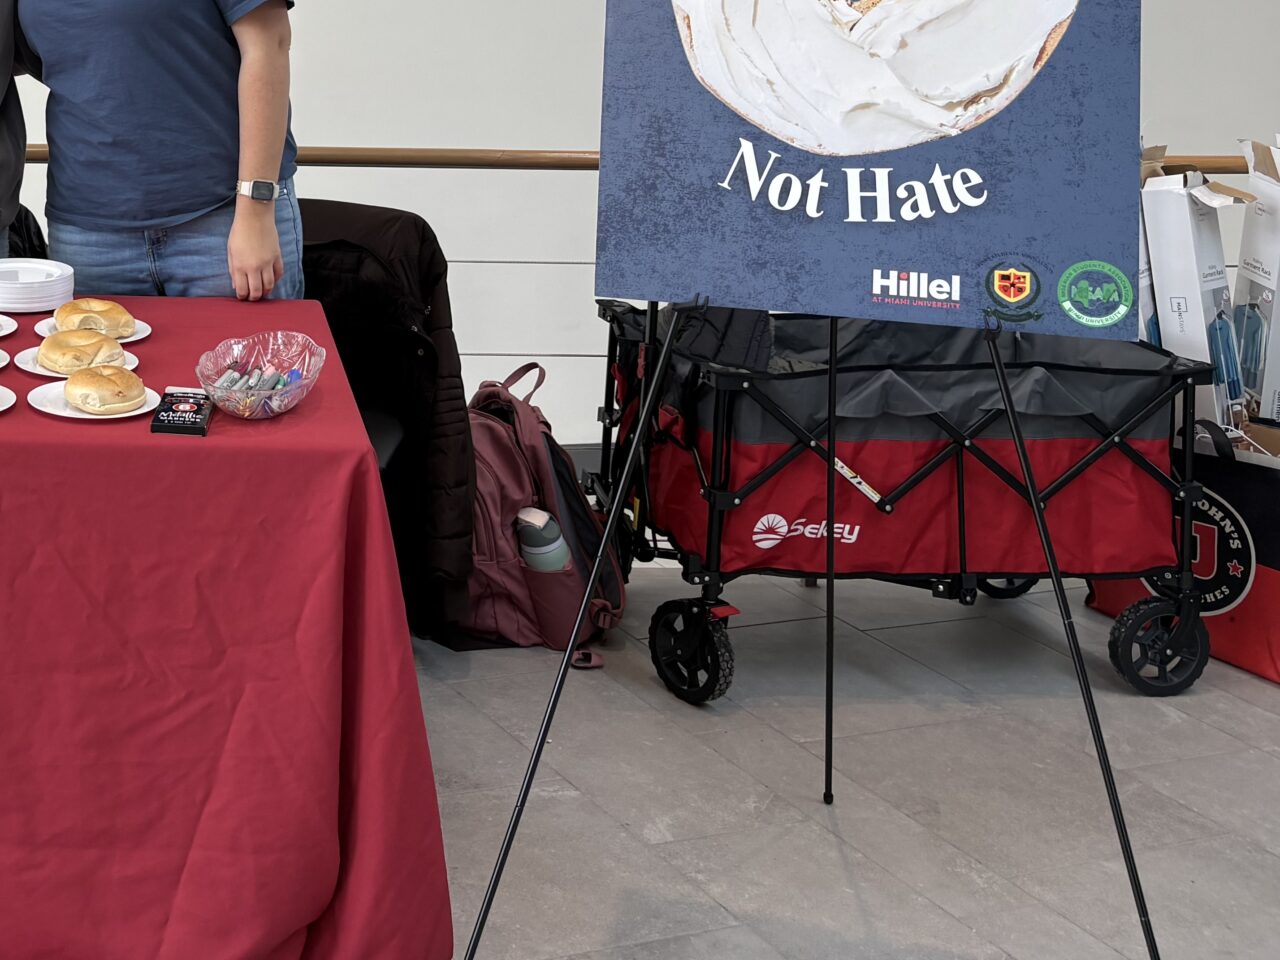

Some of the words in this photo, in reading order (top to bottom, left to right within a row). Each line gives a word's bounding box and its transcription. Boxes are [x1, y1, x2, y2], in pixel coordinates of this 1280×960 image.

[717, 137, 829, 218] Not
[841, 162, 988, 222] Hate
[872, 268, 960, 301] Hillel
[912, 300, 960, 309] UNIVERSITY
[1192, 499, 1242, 549] OHN'S
